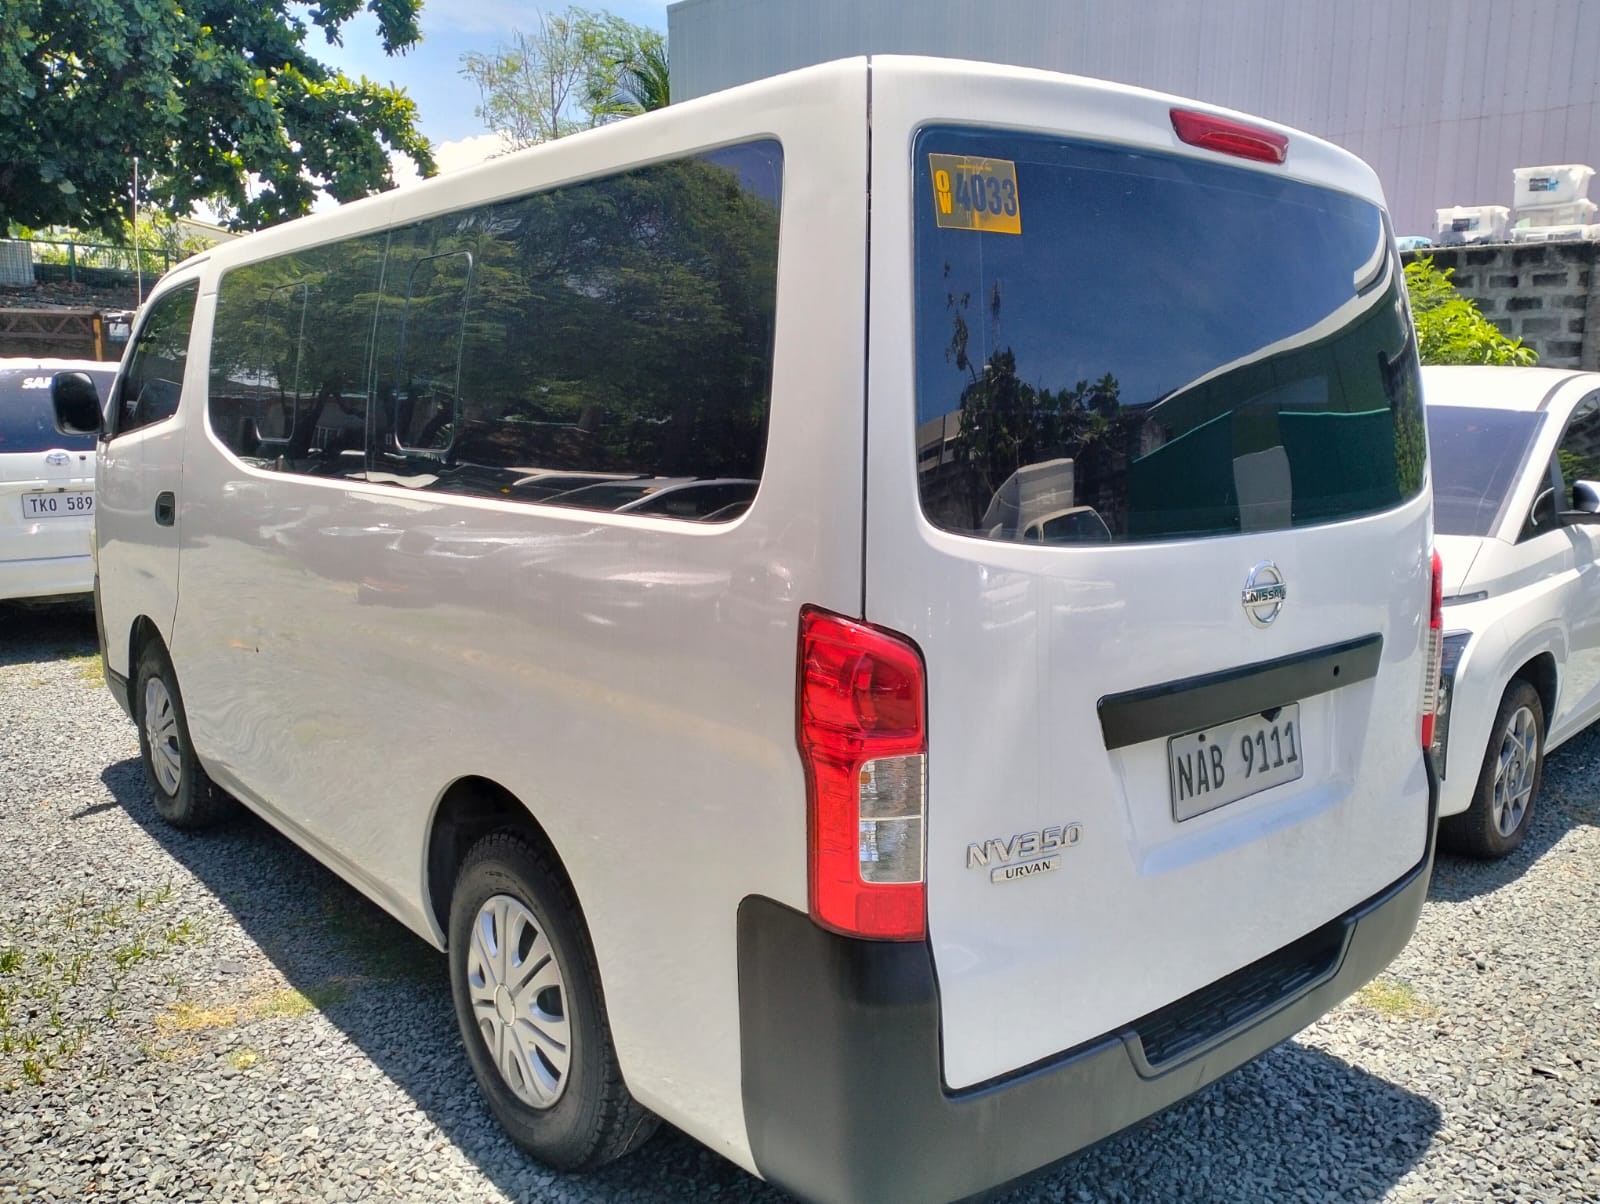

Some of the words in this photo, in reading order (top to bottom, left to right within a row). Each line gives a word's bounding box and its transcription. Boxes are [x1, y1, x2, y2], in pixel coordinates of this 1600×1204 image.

[956, 173, 1017, 216] 4033
[30, 498, 57, 512] TKO
[66, 496, 93, 511] 589
[1249, 588, 1285, 602] NISSAN
[1177, 744, 1225, 801] NAB
[1241, 720, 1298, 778] 9111
[966, 821, 1083, 869] NV350
[1005, 860, 1051, 879] URVAN
